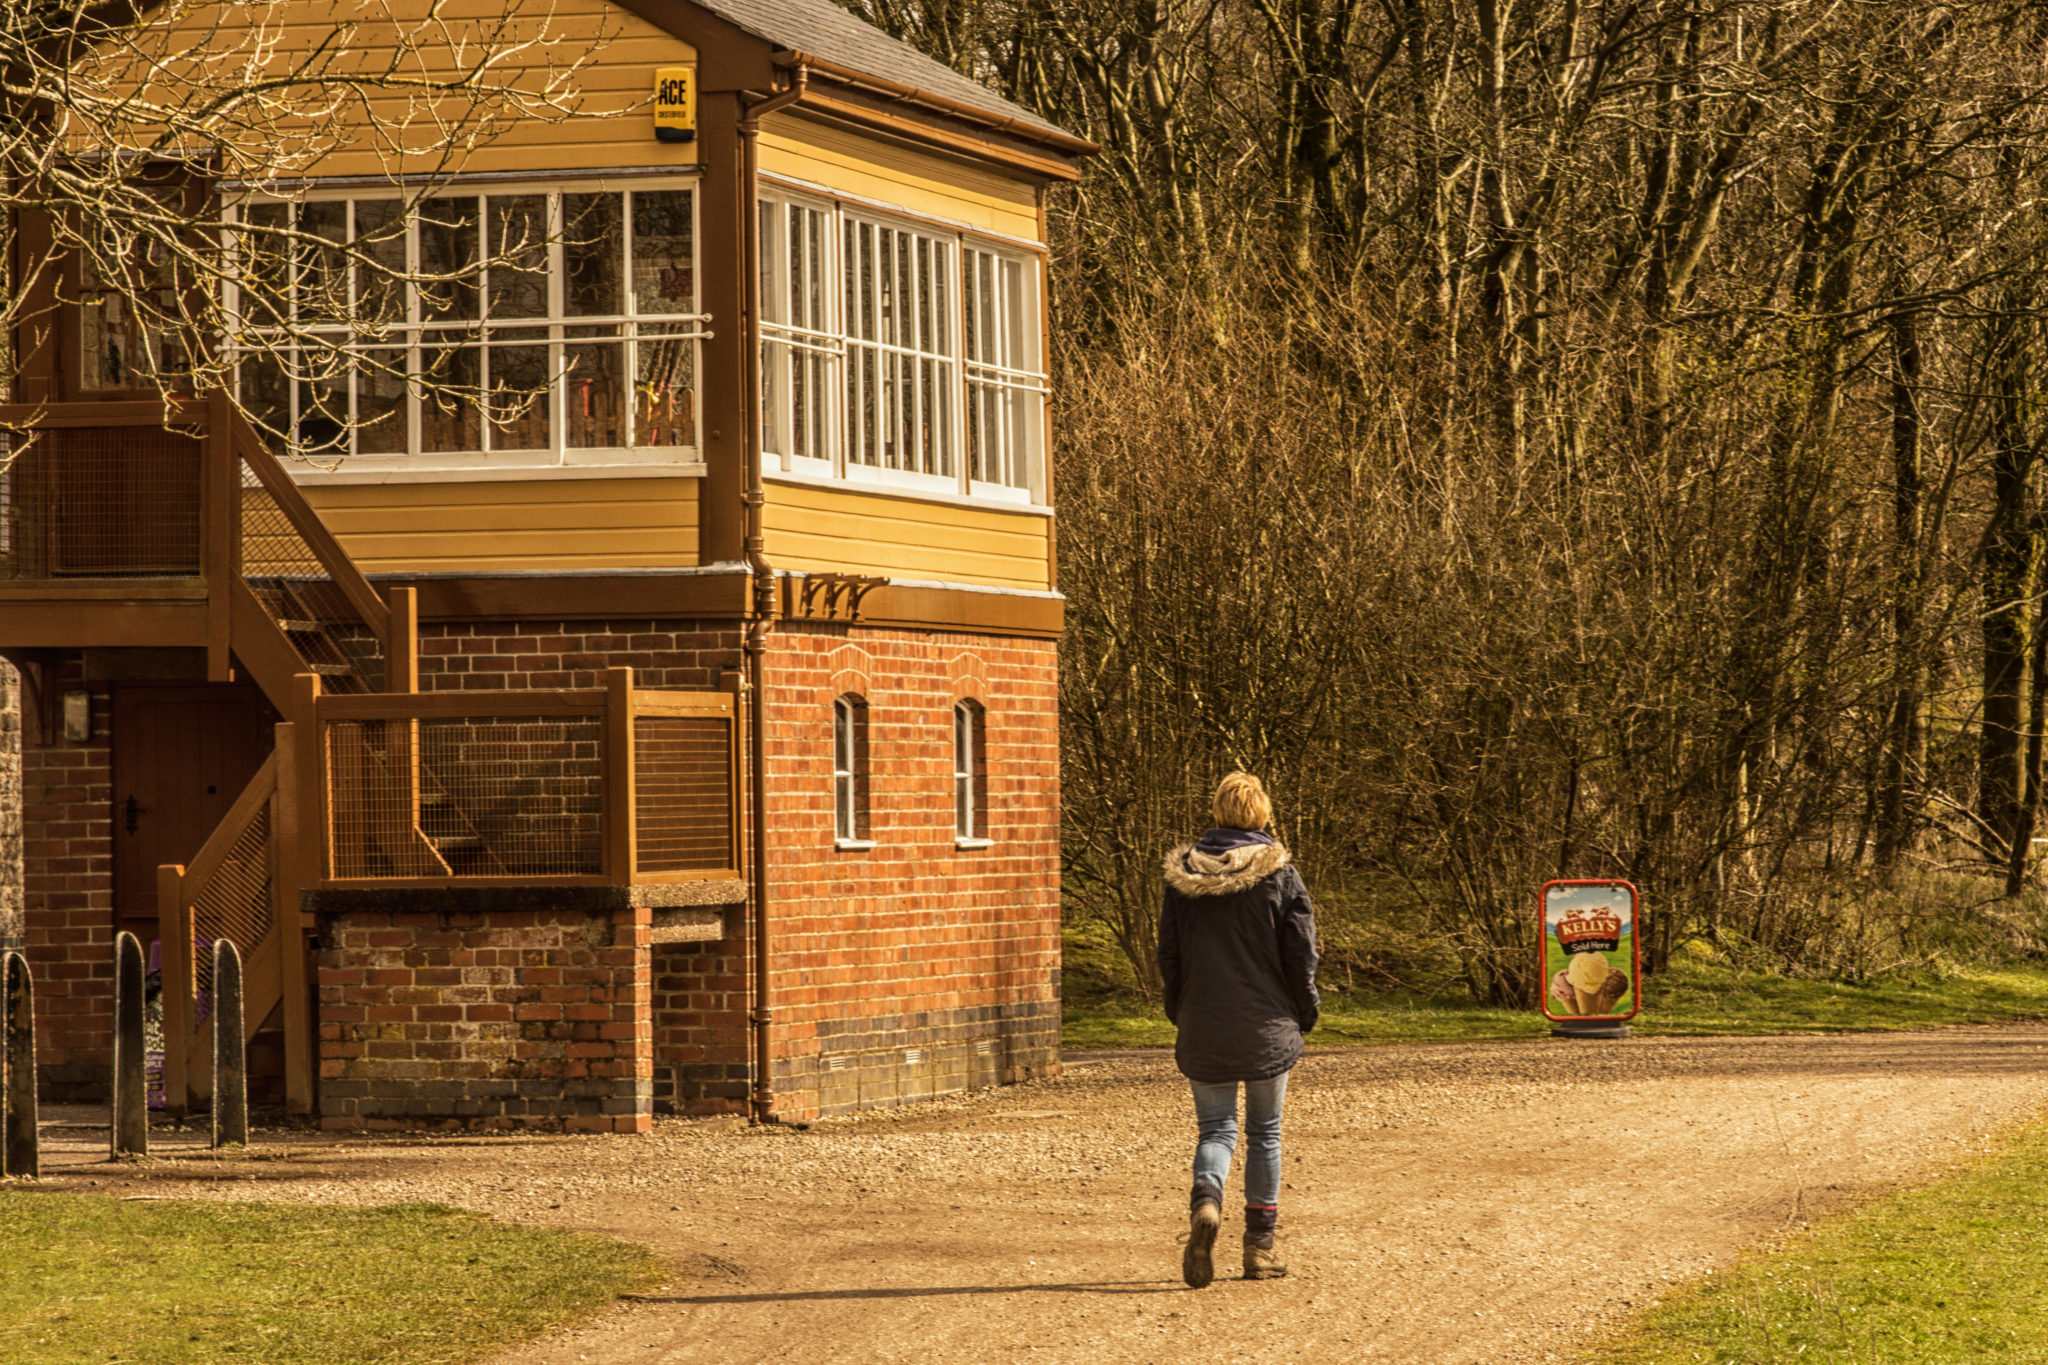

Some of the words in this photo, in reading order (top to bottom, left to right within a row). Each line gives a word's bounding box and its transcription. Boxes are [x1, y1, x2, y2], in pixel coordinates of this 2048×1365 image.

[659, 79, 687, 105] ACE
[1561, 919, 1617, 936] KELLY'S
[1571, 941, 1589, 952] Sold
[1590, 941, 1610, 950] Here
